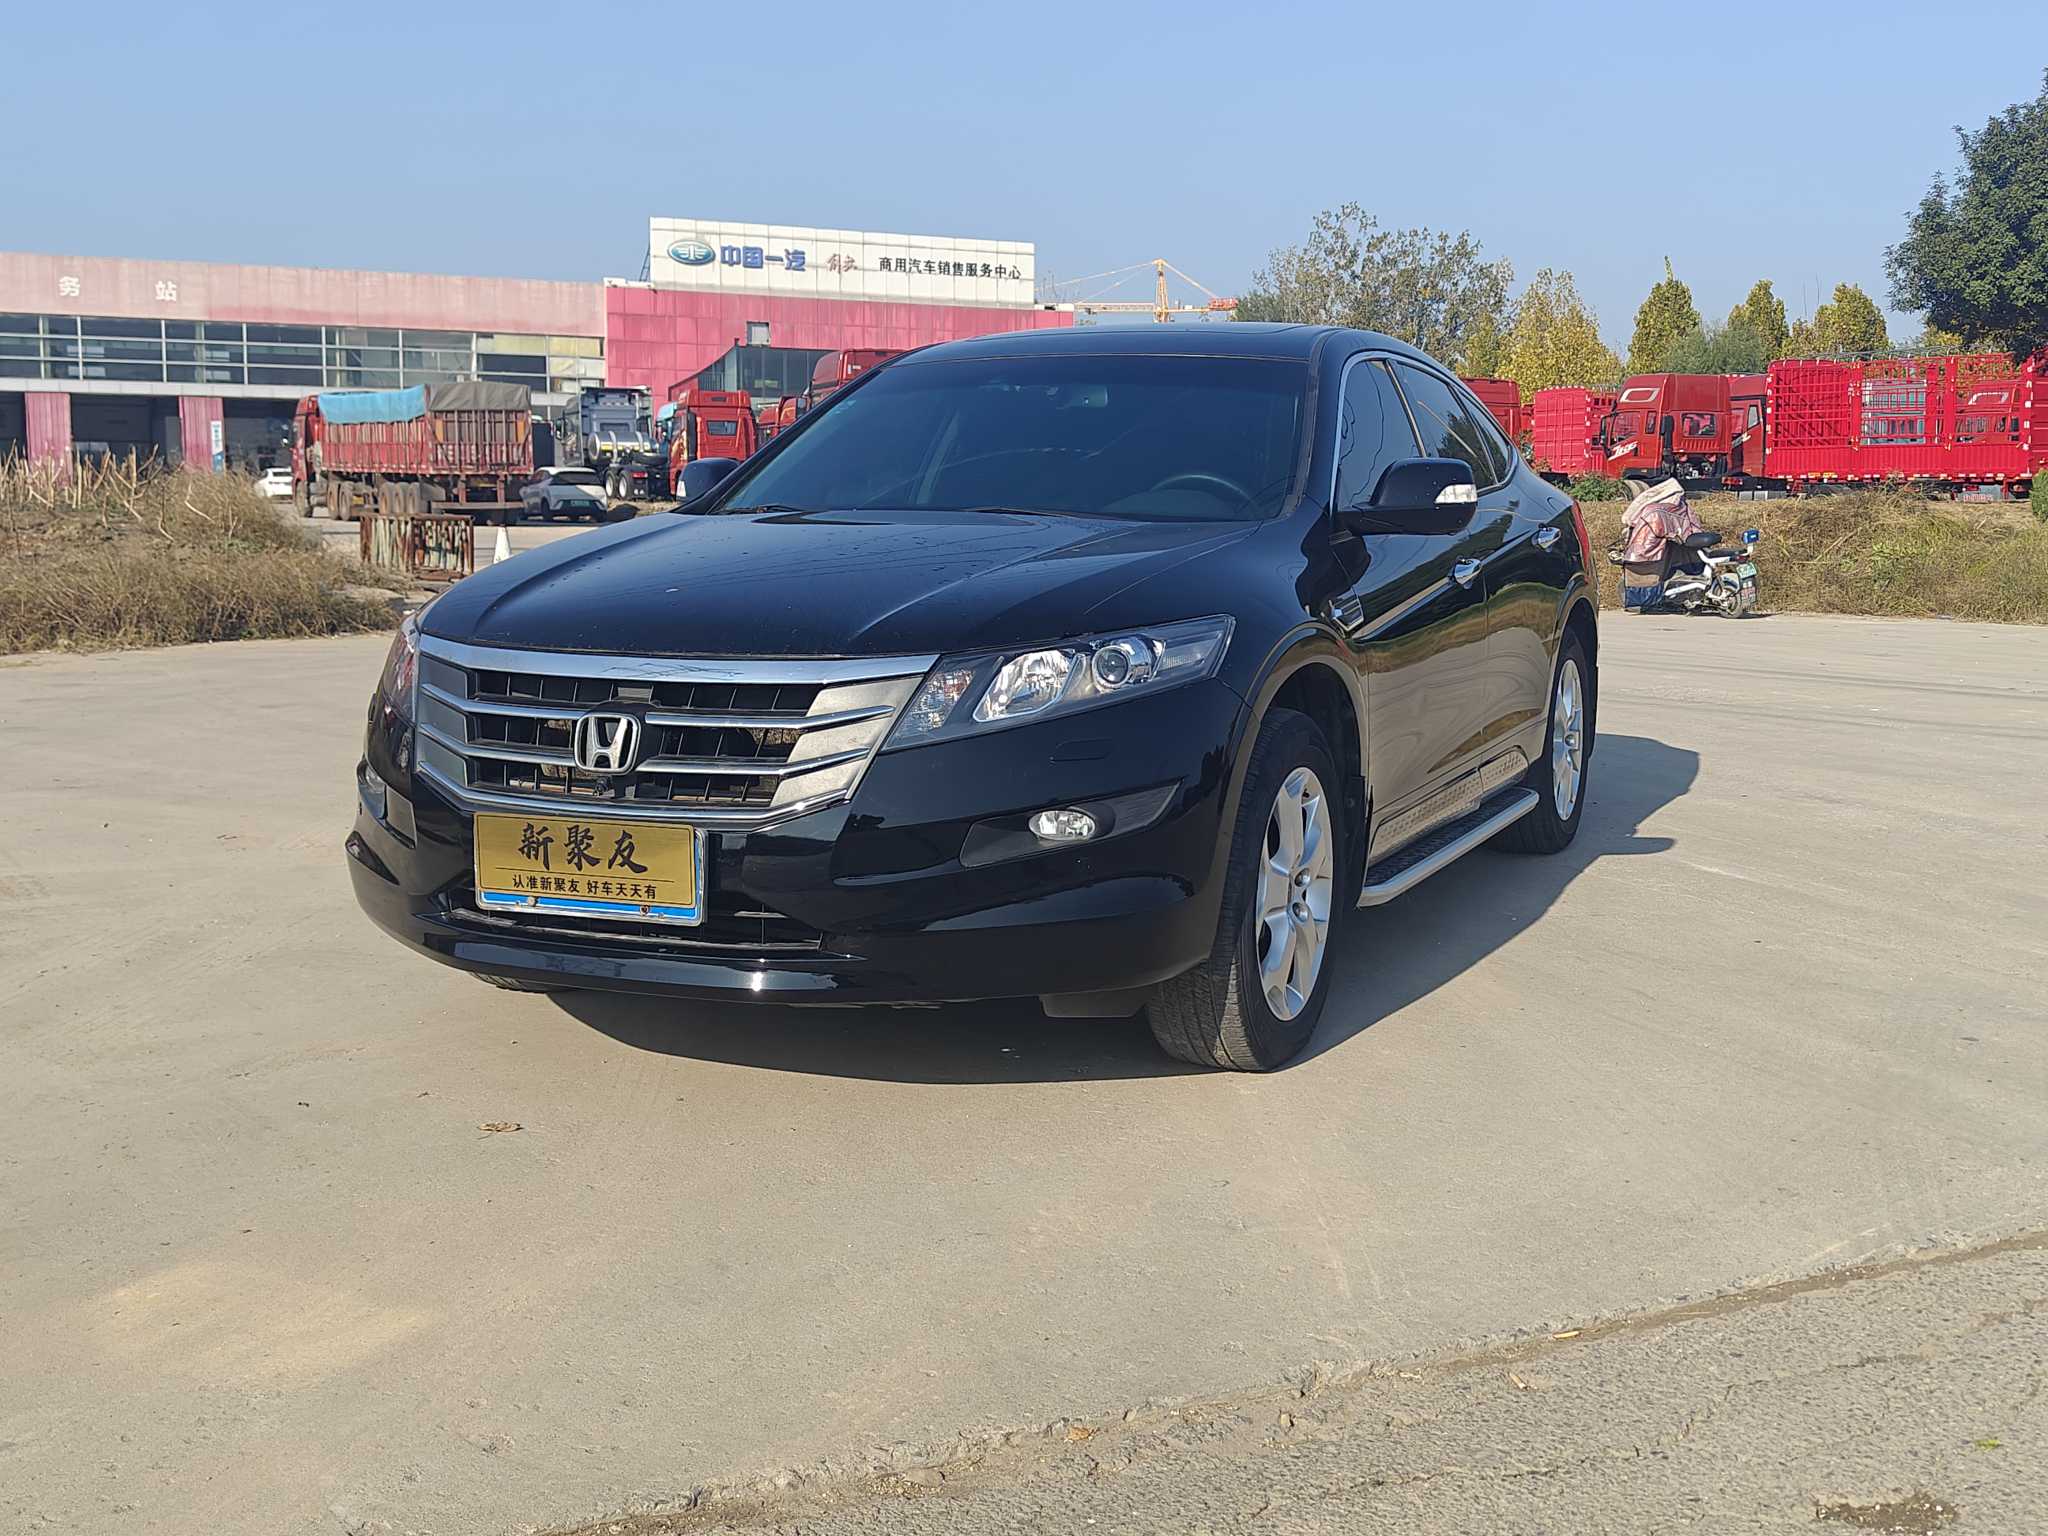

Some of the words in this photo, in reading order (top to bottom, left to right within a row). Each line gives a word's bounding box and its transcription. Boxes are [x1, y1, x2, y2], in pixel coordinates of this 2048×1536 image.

[719, 244, 806, 272] 中国一汽
[878, 256, 1022, 280] 商用汽车销售服务中心
[518, 822, 648, 874] 新聚友
[511, 873, 581, 894] 认准新聚友
[586, 880, 658, 900] 好车天天有
